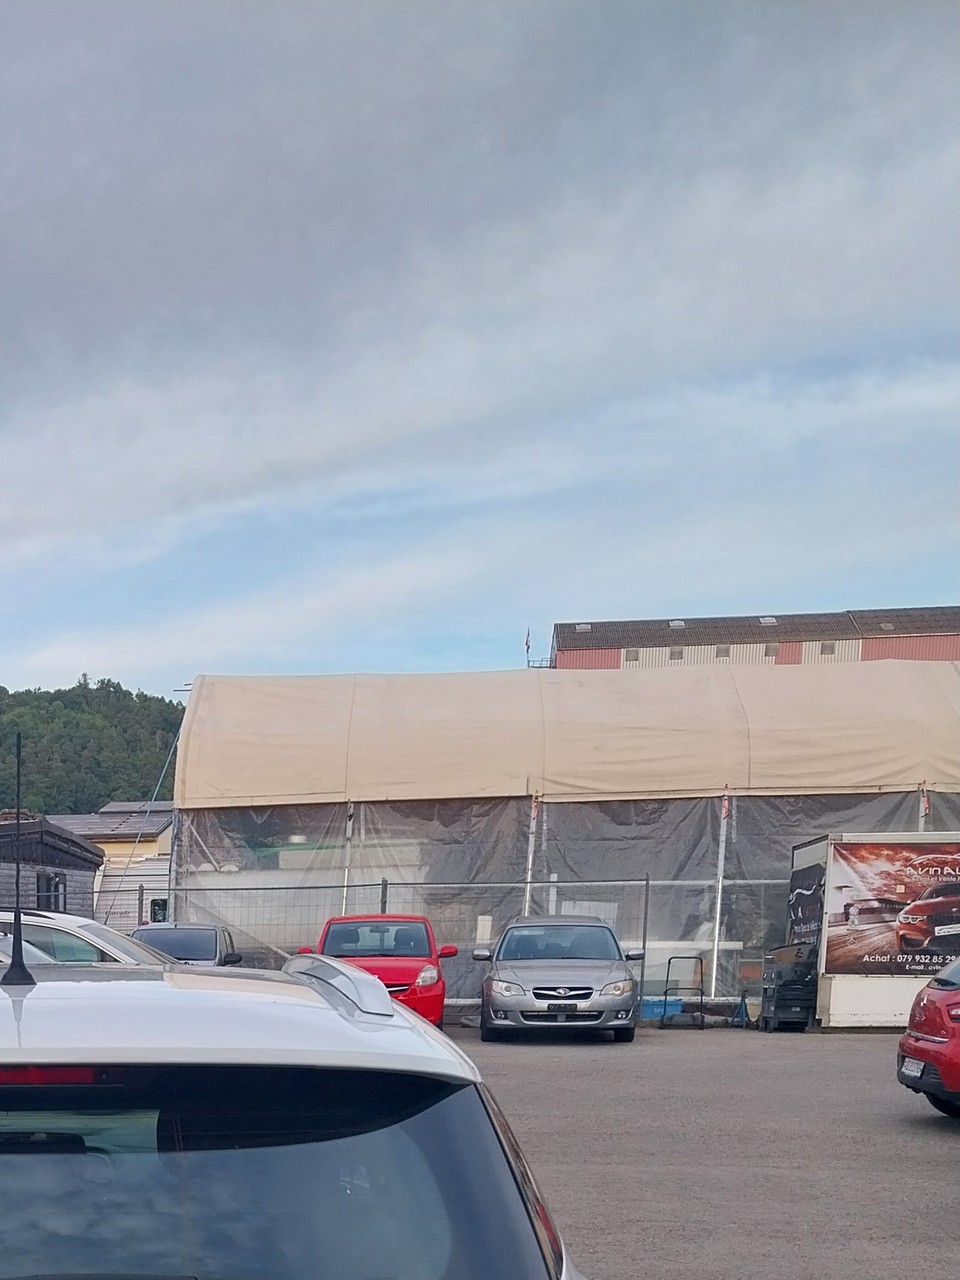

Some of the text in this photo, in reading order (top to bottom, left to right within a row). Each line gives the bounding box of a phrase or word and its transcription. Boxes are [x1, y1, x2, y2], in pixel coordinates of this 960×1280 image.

[862, 954, 890, 962] Achat
[897, 954, 913, 963] 079
[915, 954, 931, 963] 932
[932, 955, 944, 963] 85
